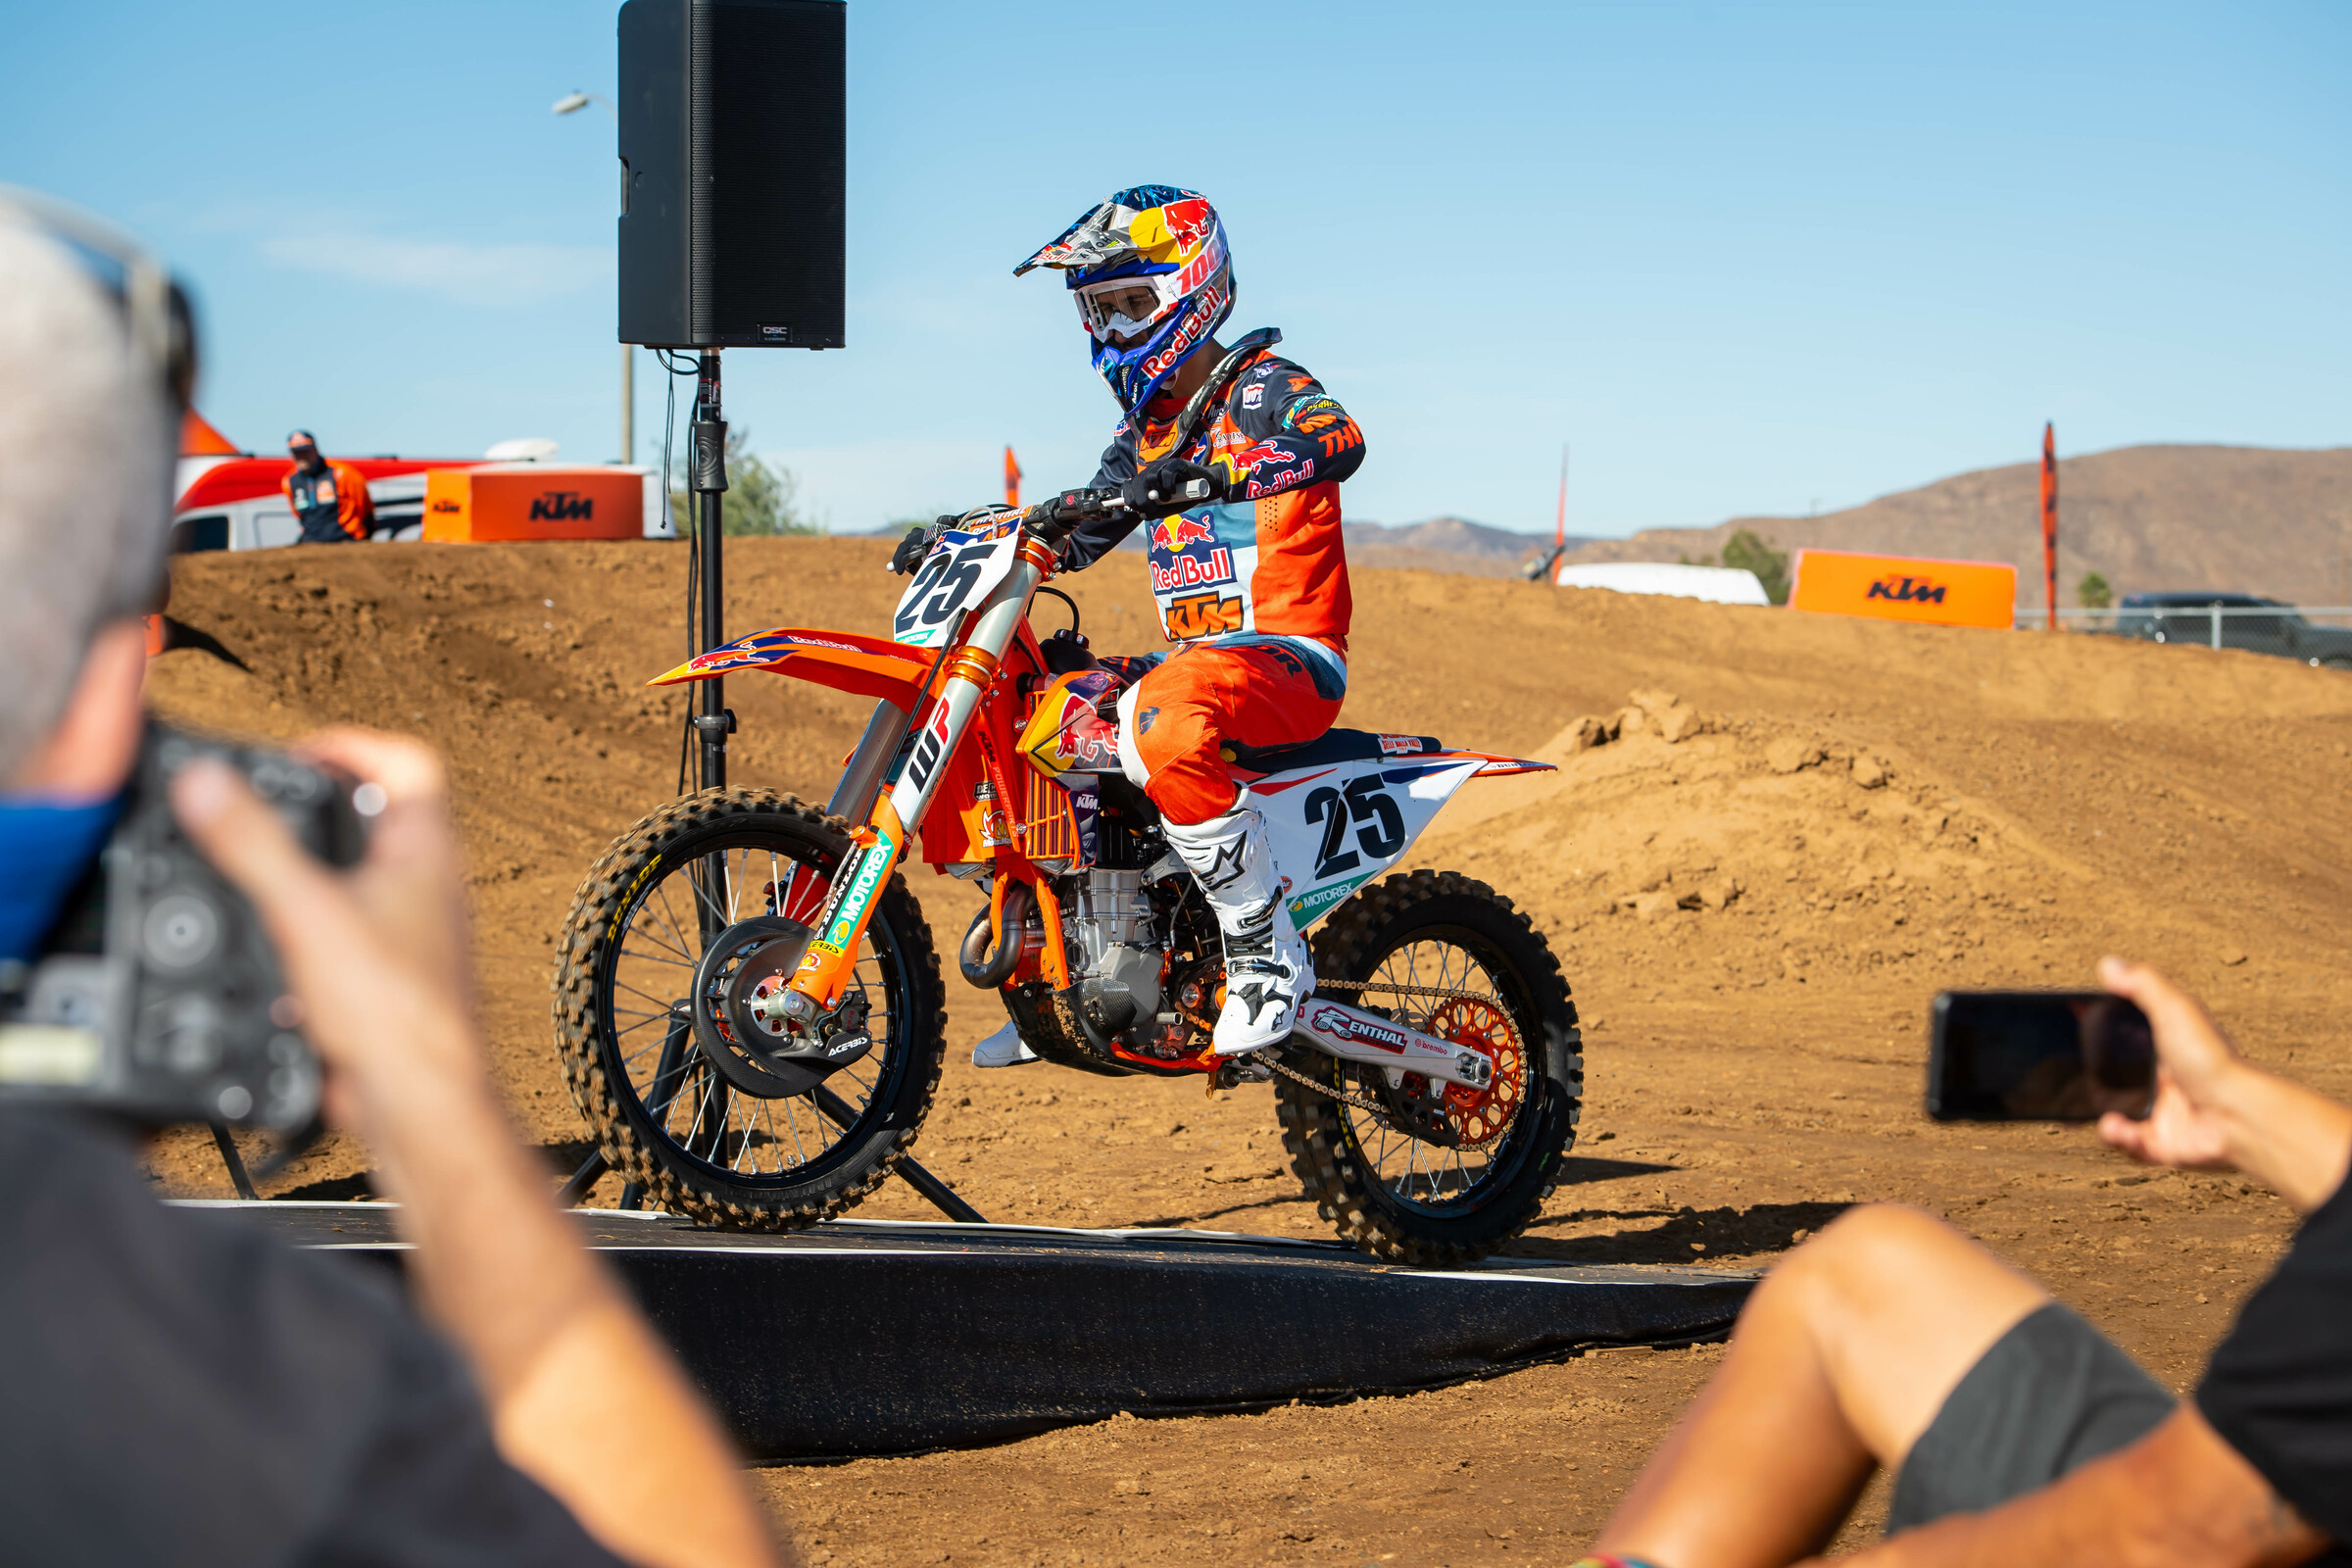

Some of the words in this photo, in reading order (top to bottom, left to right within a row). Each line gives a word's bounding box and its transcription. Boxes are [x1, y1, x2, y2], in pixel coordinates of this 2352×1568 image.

[1141, 327, 1193, 380] Red
[1180, 282, 1223, 340] Bull
[1141, 430, 1177, 452] KTM
[1246, 472, 1283, 500] Red
[1280, 458, 1314, 489] Bull
[529, 492, 594, 521] KTM
[1151, 555, 1185, 591] Red
[1179, 547, 1232, 586] Bull
[895, 543, 1000, 634] 25
[1866, 575, 1946, 604] KTM
[1165, 590, 1245, 642] KTM
[1076, 794, 1098, 809] KTM
[1304, 772, 1407, 881] 25
[840, 840, 893, 922] MOTOREX
[1302, 882, 1353, 909] MOTOREX
[827, 1037, 868, 1057] ACERBIS
[1421, 1040, 1448, 1055] brembo
